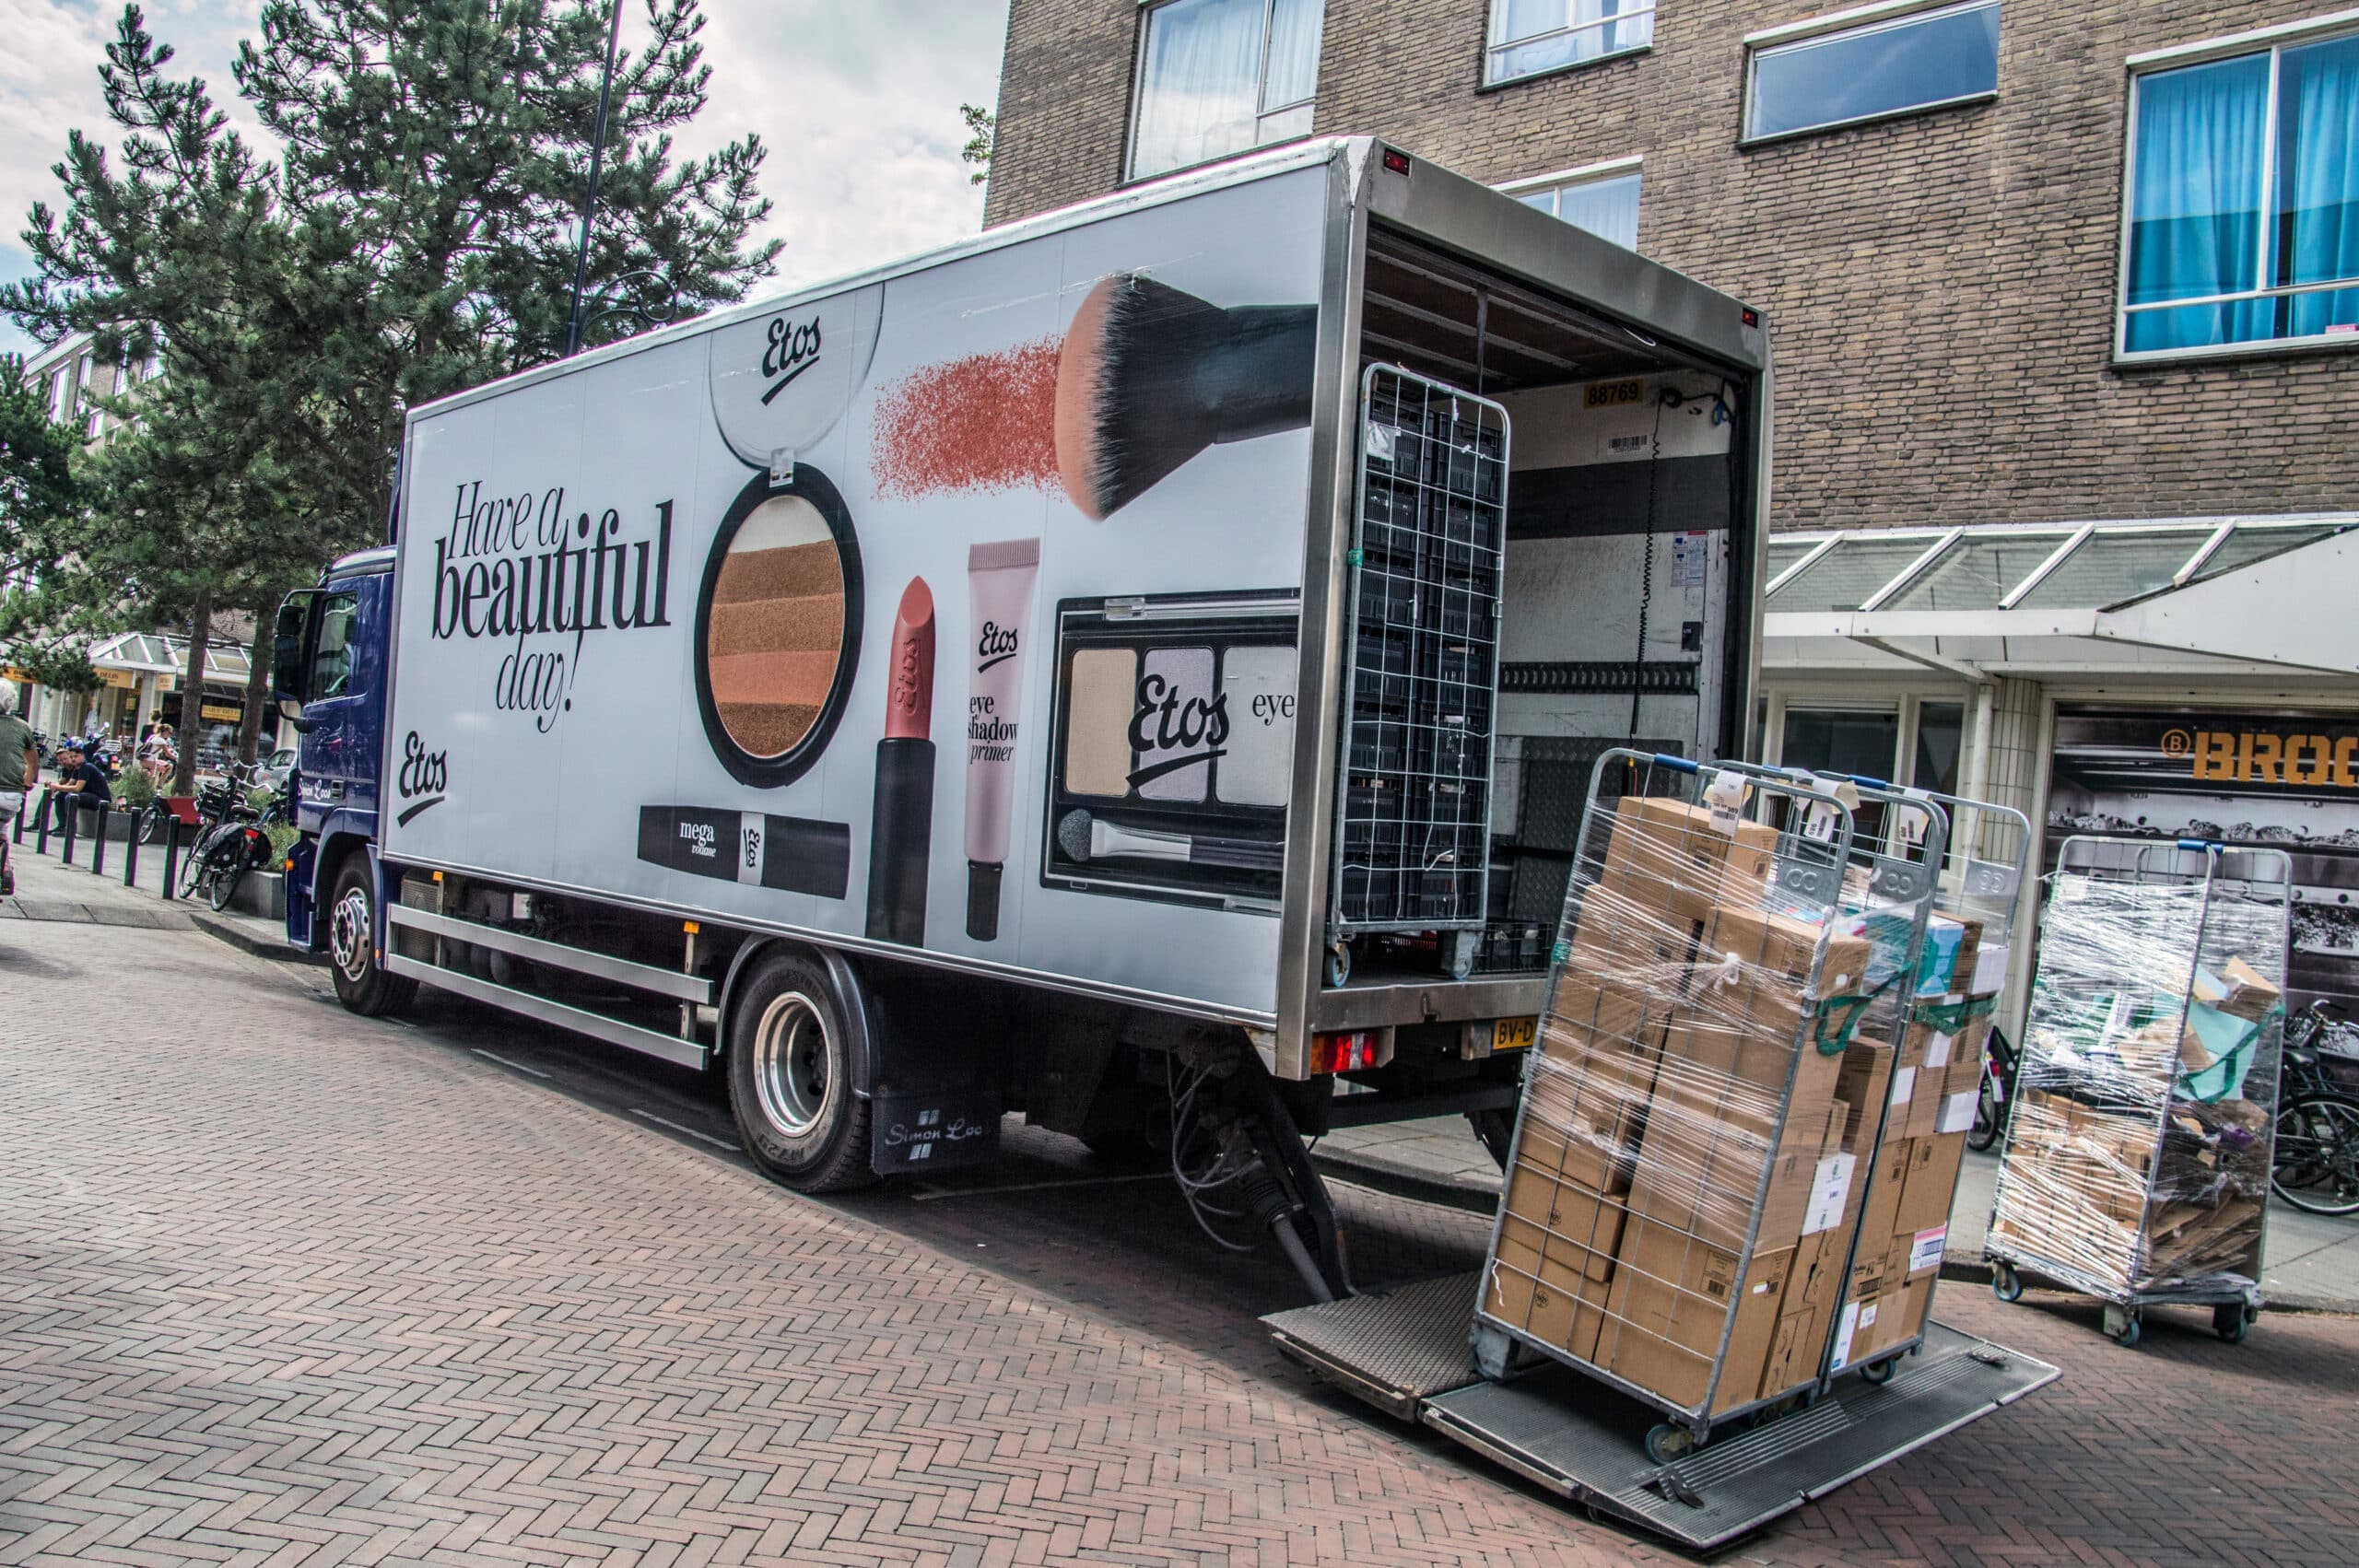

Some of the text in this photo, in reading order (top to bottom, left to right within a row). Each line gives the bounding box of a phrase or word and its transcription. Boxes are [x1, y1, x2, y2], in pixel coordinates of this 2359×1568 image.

[762, 315, 822, 380] Etos
[1589, 382, 1638, 405] 88769
[447, 480, 565, 559] Have a
[432, 498, 675, 639] beautiful
[979, 620, 1020, 658] Etos
[496, 626, 584, 733] day!
[969, 694, 995, 723] eye
[1128, 673, 1295, 757] Etos eye
[968, 716, 1019, 742] shadow
[398, 729, 448, 802] Etos
[969, 741, 1014, 765] primer
[679, 822, 715, 847] mega
[745, 827, 761, 869] Etos
[885, 1123, 941, 1145] Simon
